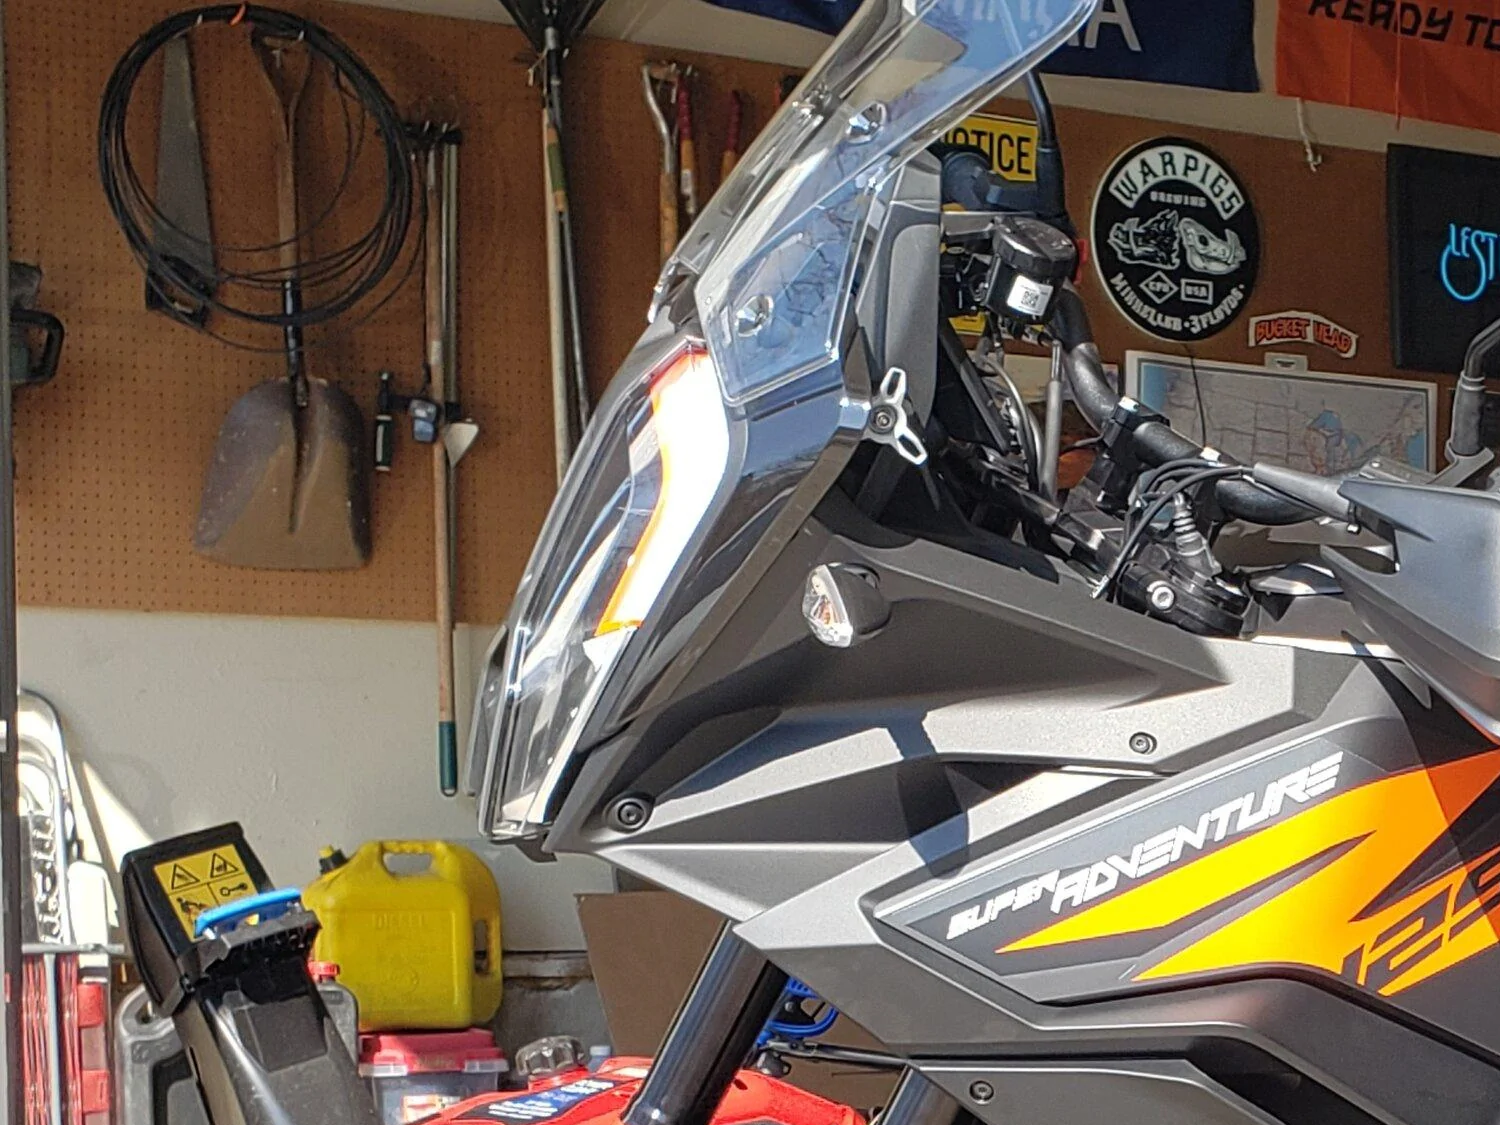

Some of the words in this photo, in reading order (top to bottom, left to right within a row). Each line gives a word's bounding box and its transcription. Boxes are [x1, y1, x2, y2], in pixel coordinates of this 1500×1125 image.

[1114, 151, 1243, 219] WARPIGS
[1255, 317, 1310, 343] BUCKET
[1050, 751, 1344, 914] ADVENTURE
